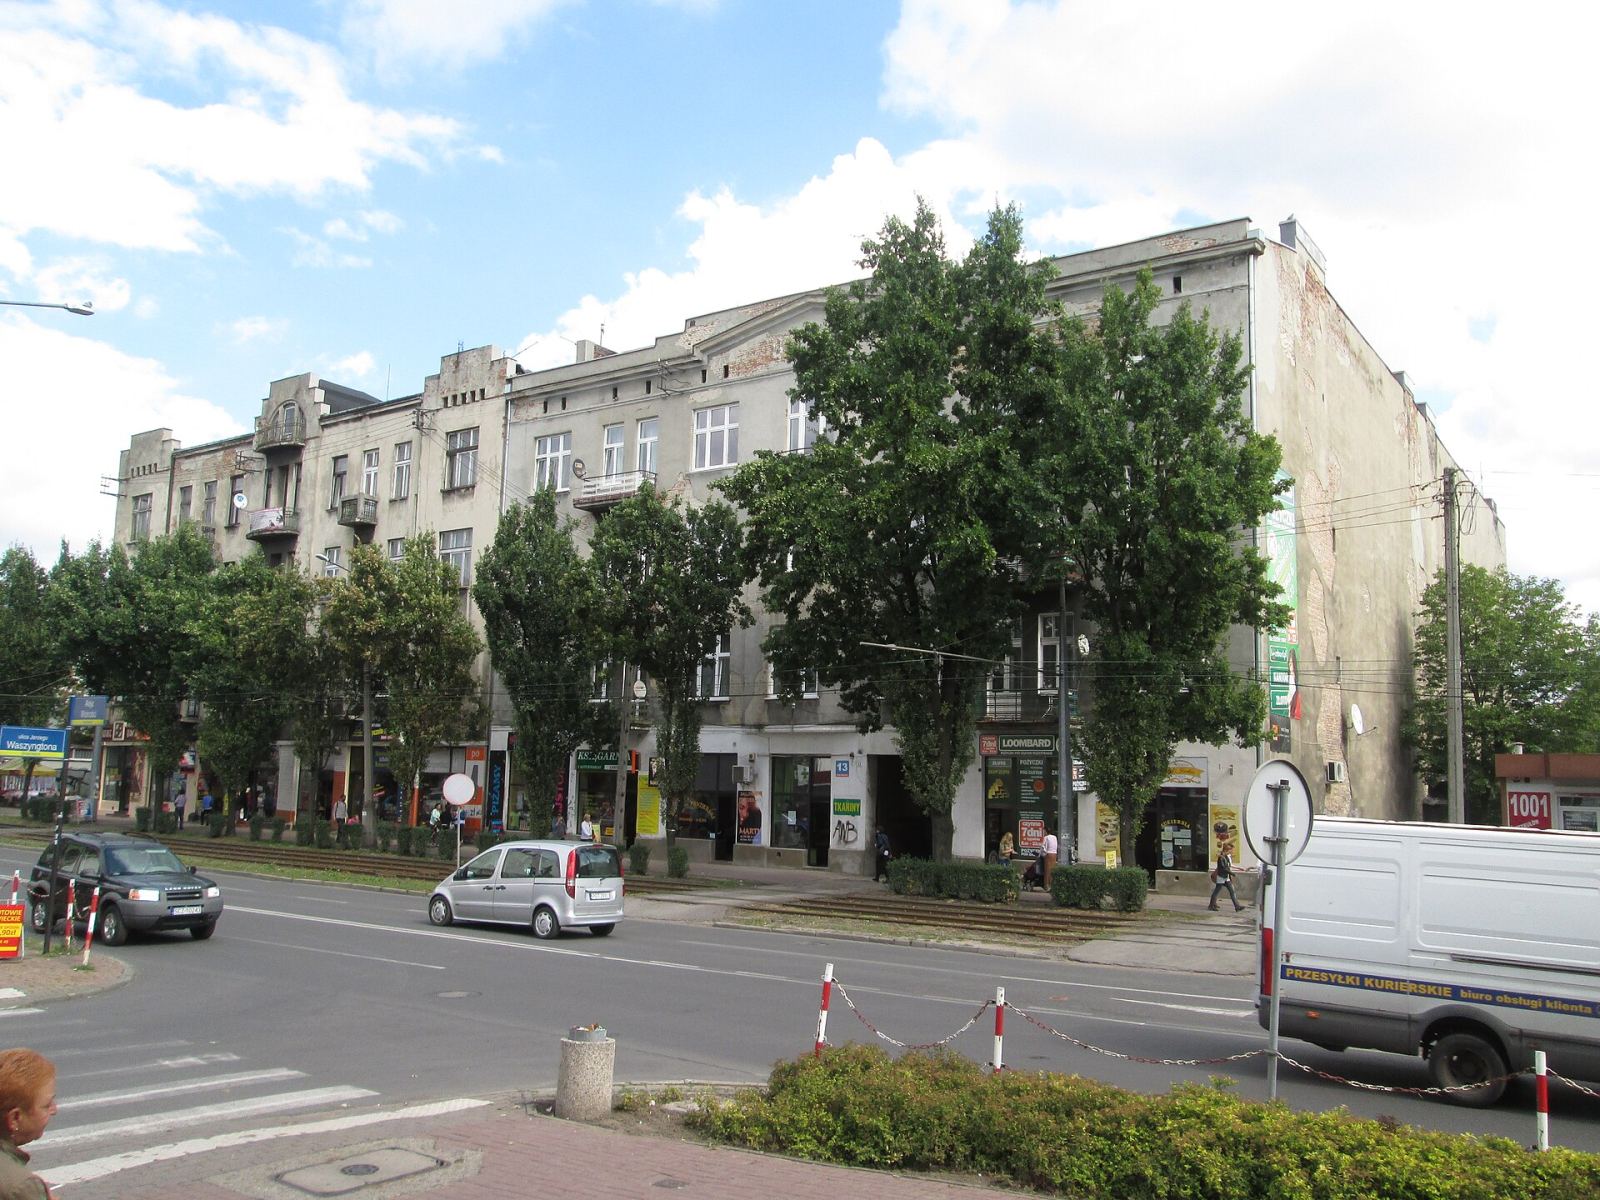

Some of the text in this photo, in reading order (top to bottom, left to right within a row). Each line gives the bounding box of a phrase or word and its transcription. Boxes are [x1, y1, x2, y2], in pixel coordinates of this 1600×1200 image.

[6, 740, 58, 753] Waszyngtona
[1002, 738, 1052, 748] LOOMBARD
[578, 751, 631, 762] KSGARNA
[836, 762, 849, 772] 13
[834, 801, 861, 813] TKANINY
[1510, 793, 1548, 818] 1001
[1286, 967, 1593, 1014] PRZESYŁKI KURIERSKIE biuro obsługi klienta
